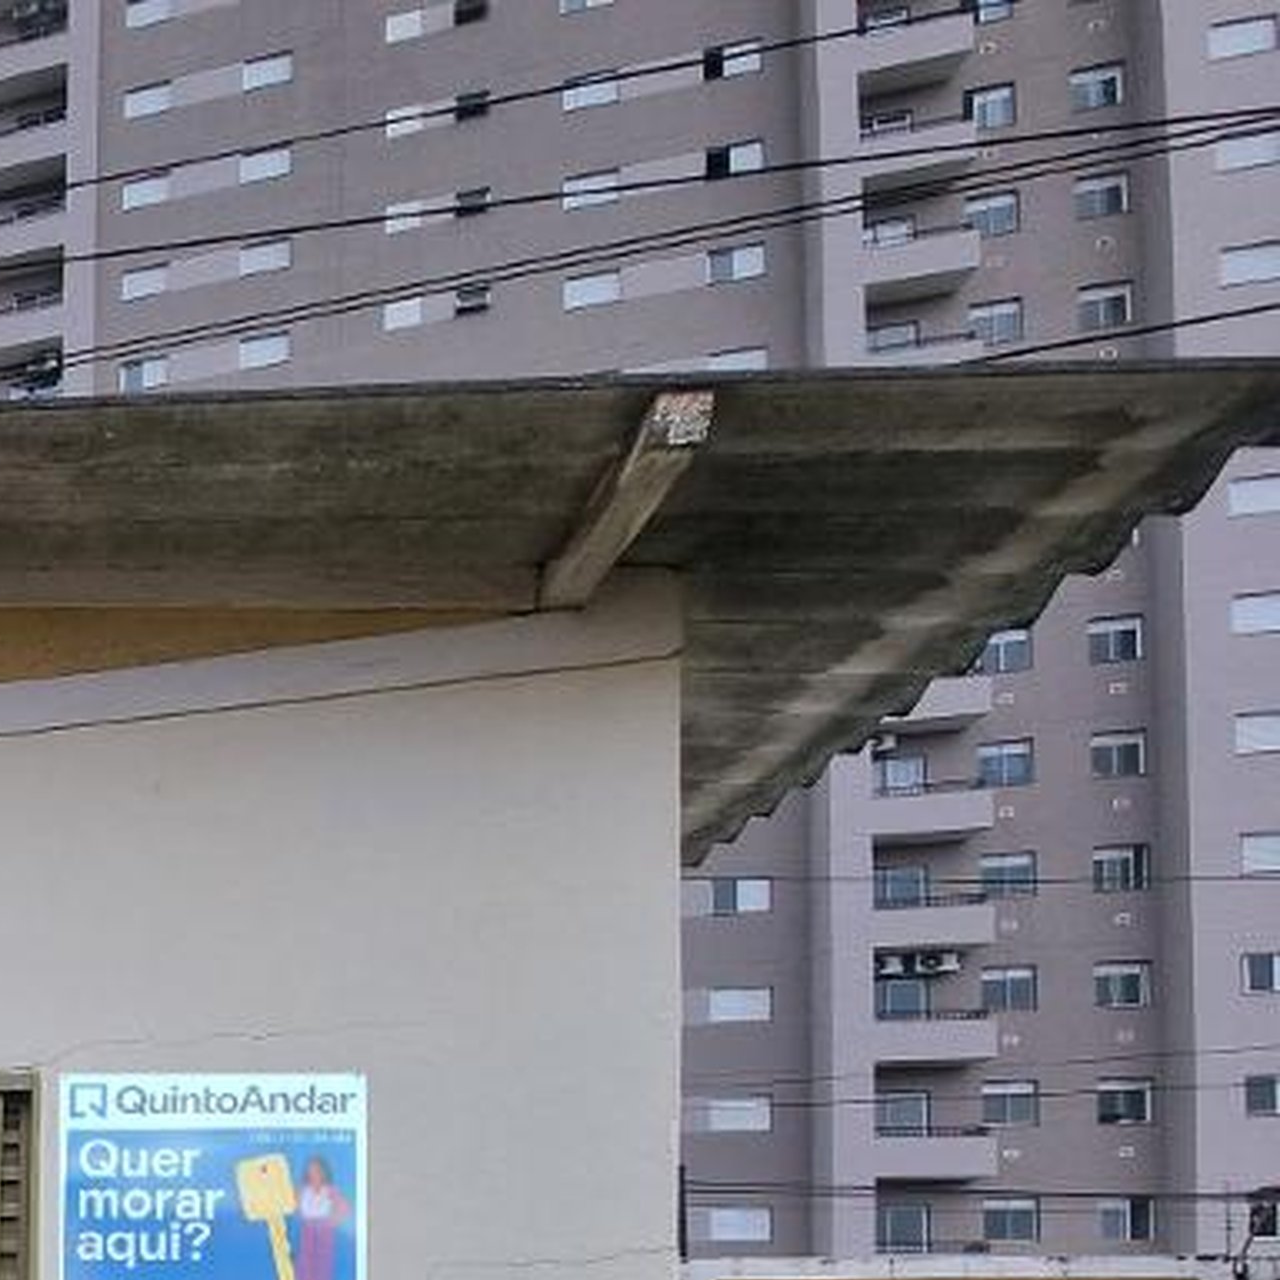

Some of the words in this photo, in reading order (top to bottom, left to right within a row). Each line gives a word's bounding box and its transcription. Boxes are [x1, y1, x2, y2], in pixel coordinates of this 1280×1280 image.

[115, 1085, 357, 1116] QuintoAndar
[79, 1139, 202, 1178] Quer
[78, 1188, 225, 1220] morar
[76, 1223, 212, 1269] aqui?
